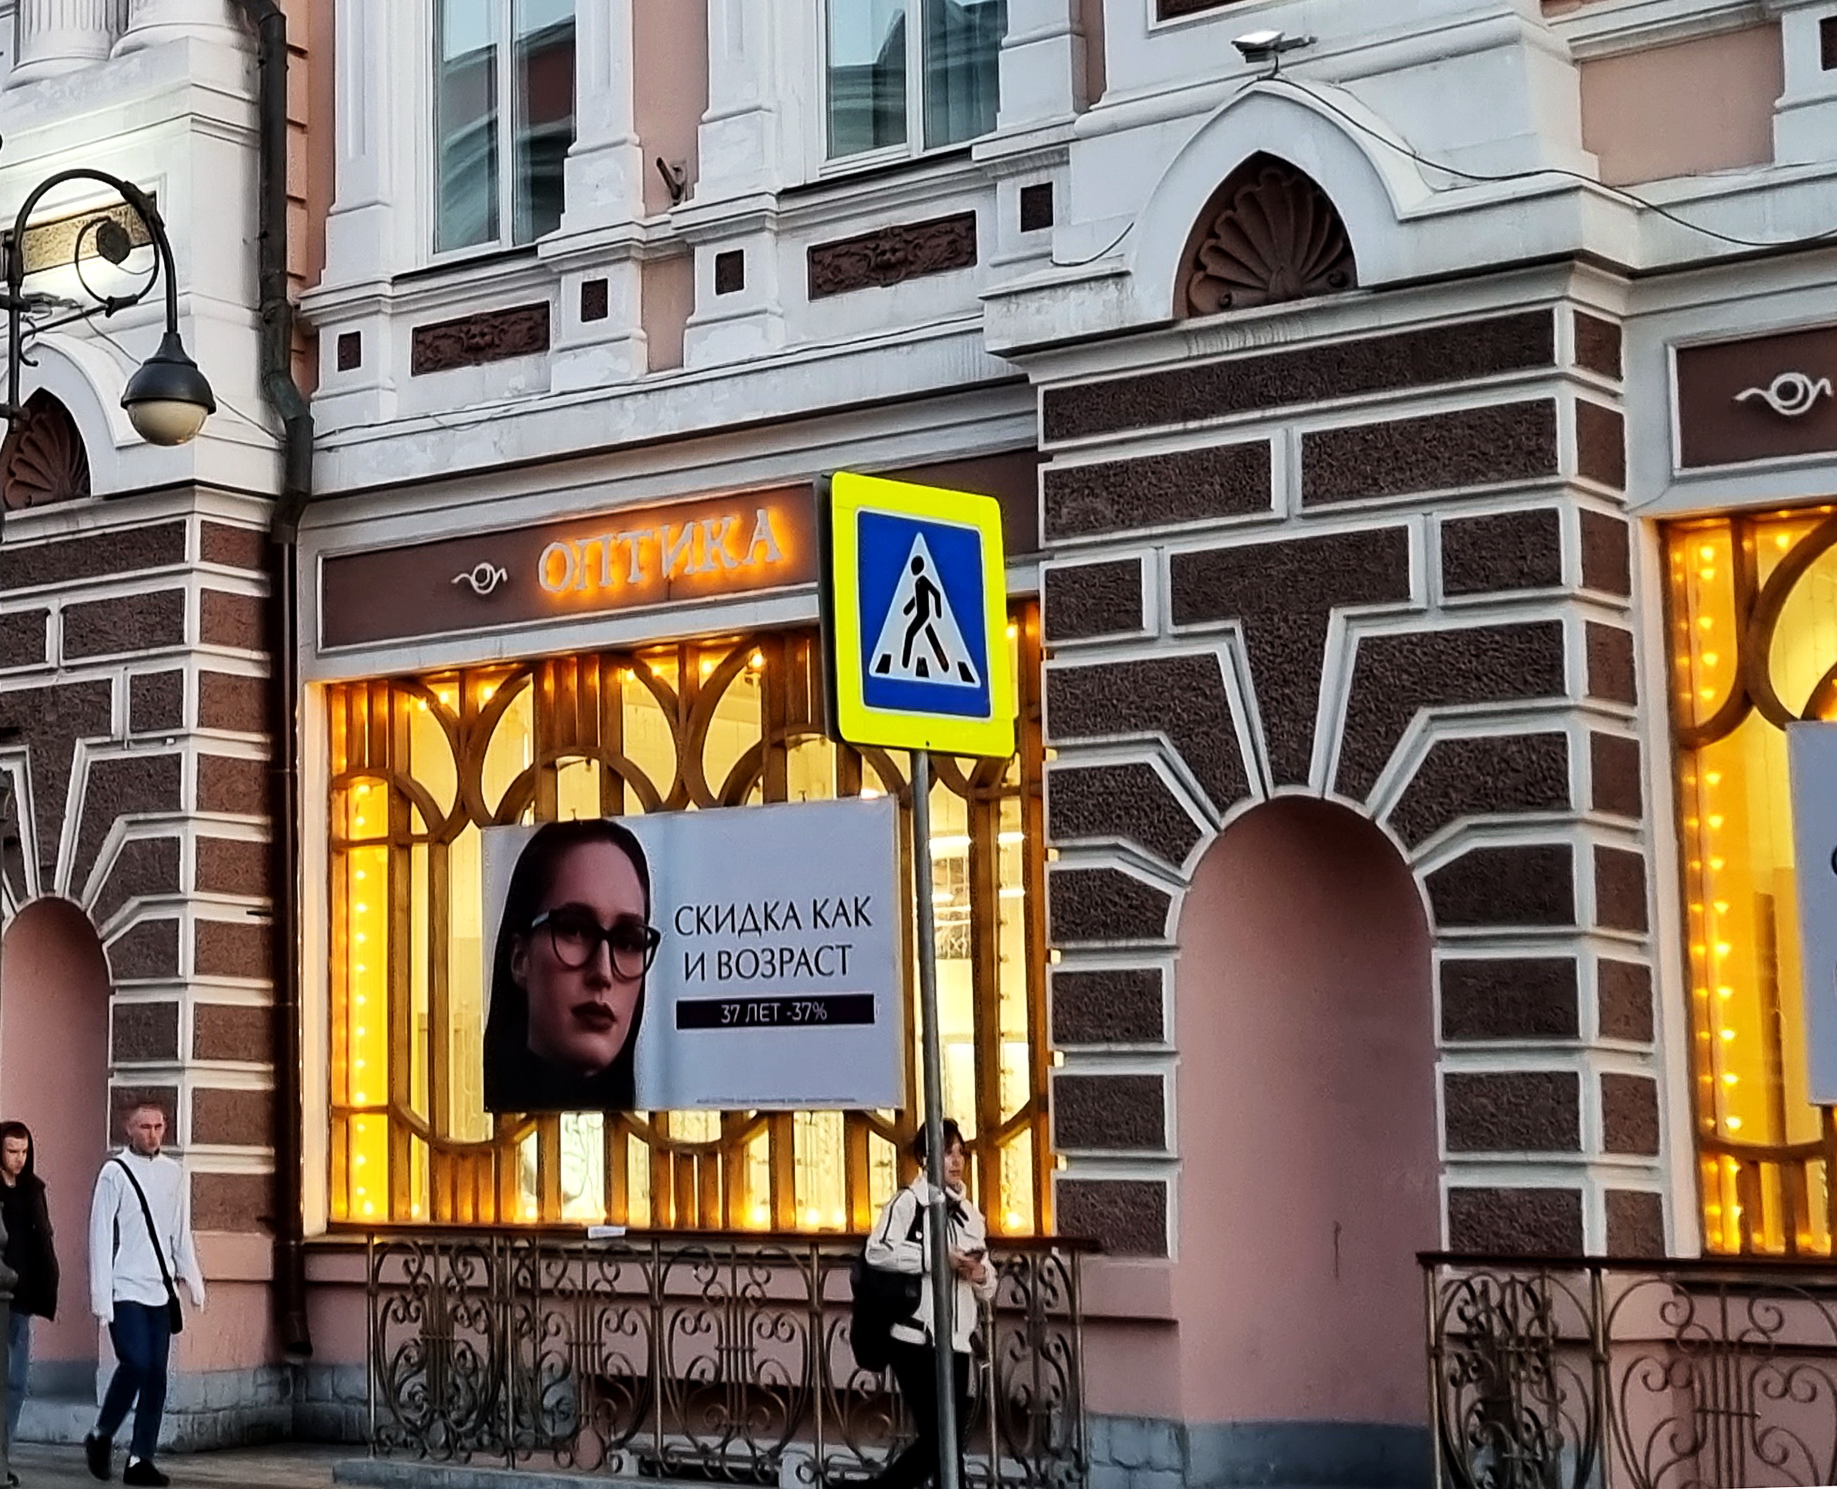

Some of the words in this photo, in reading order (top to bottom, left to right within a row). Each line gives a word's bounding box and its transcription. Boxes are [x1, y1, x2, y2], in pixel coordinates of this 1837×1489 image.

[537, 508, 784, 593] ОПТИКА
[674, 900, 803, 939] СКИДКА
[812, 895, 873, 930] КАК
[683, 951, 706, 982] И
[717, 944, 853, 981] ВОЗРАСТ
[720, 1003, 741, 1024] 37
[745, 1002, 781, 1024] ЛЕТ
[786, 1000, 829, 1022] -37%
